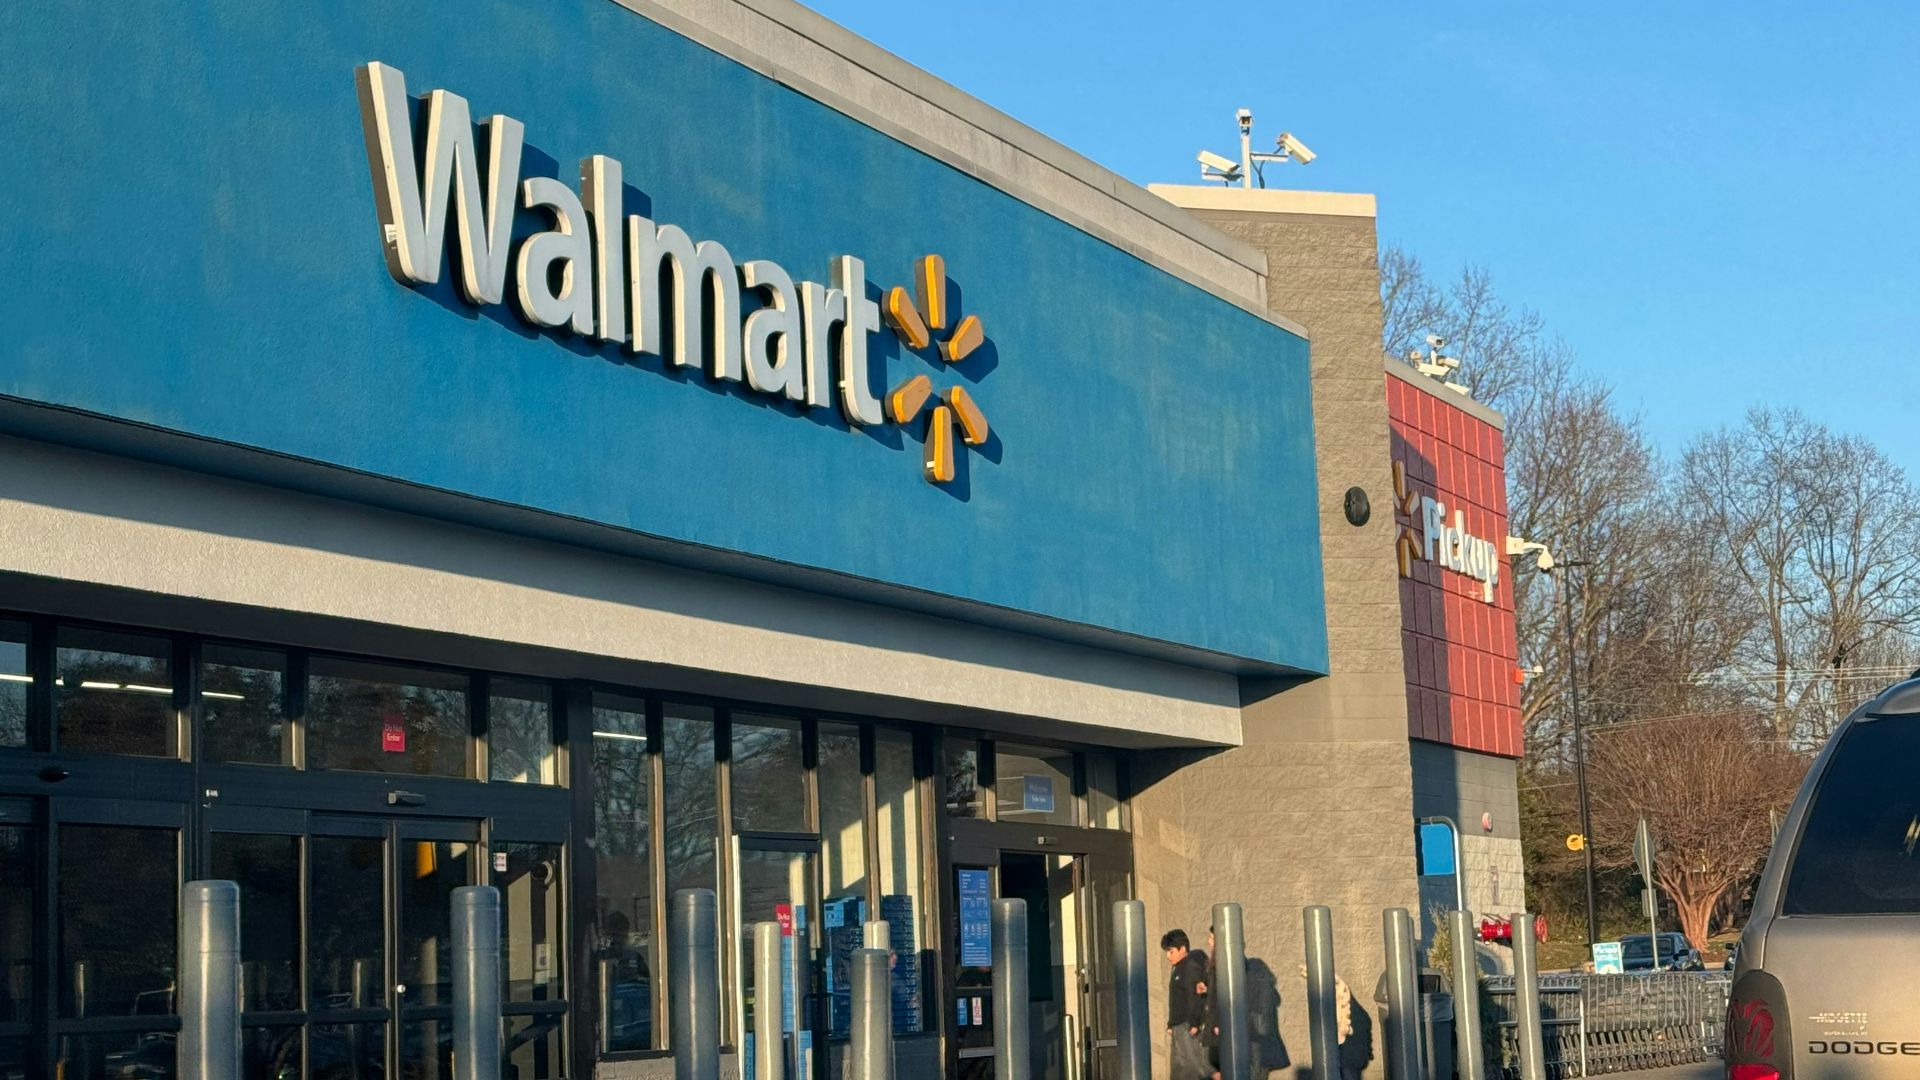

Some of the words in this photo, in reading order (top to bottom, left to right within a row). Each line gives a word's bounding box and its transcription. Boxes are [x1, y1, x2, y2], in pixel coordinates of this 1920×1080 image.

[356, 61, 884, 426] Walmart
[1421, 496, 1499, 603] Pickup
[386, 733, 401, 742] Enter
[1808, 1041, 1920, 1055] DODGE
